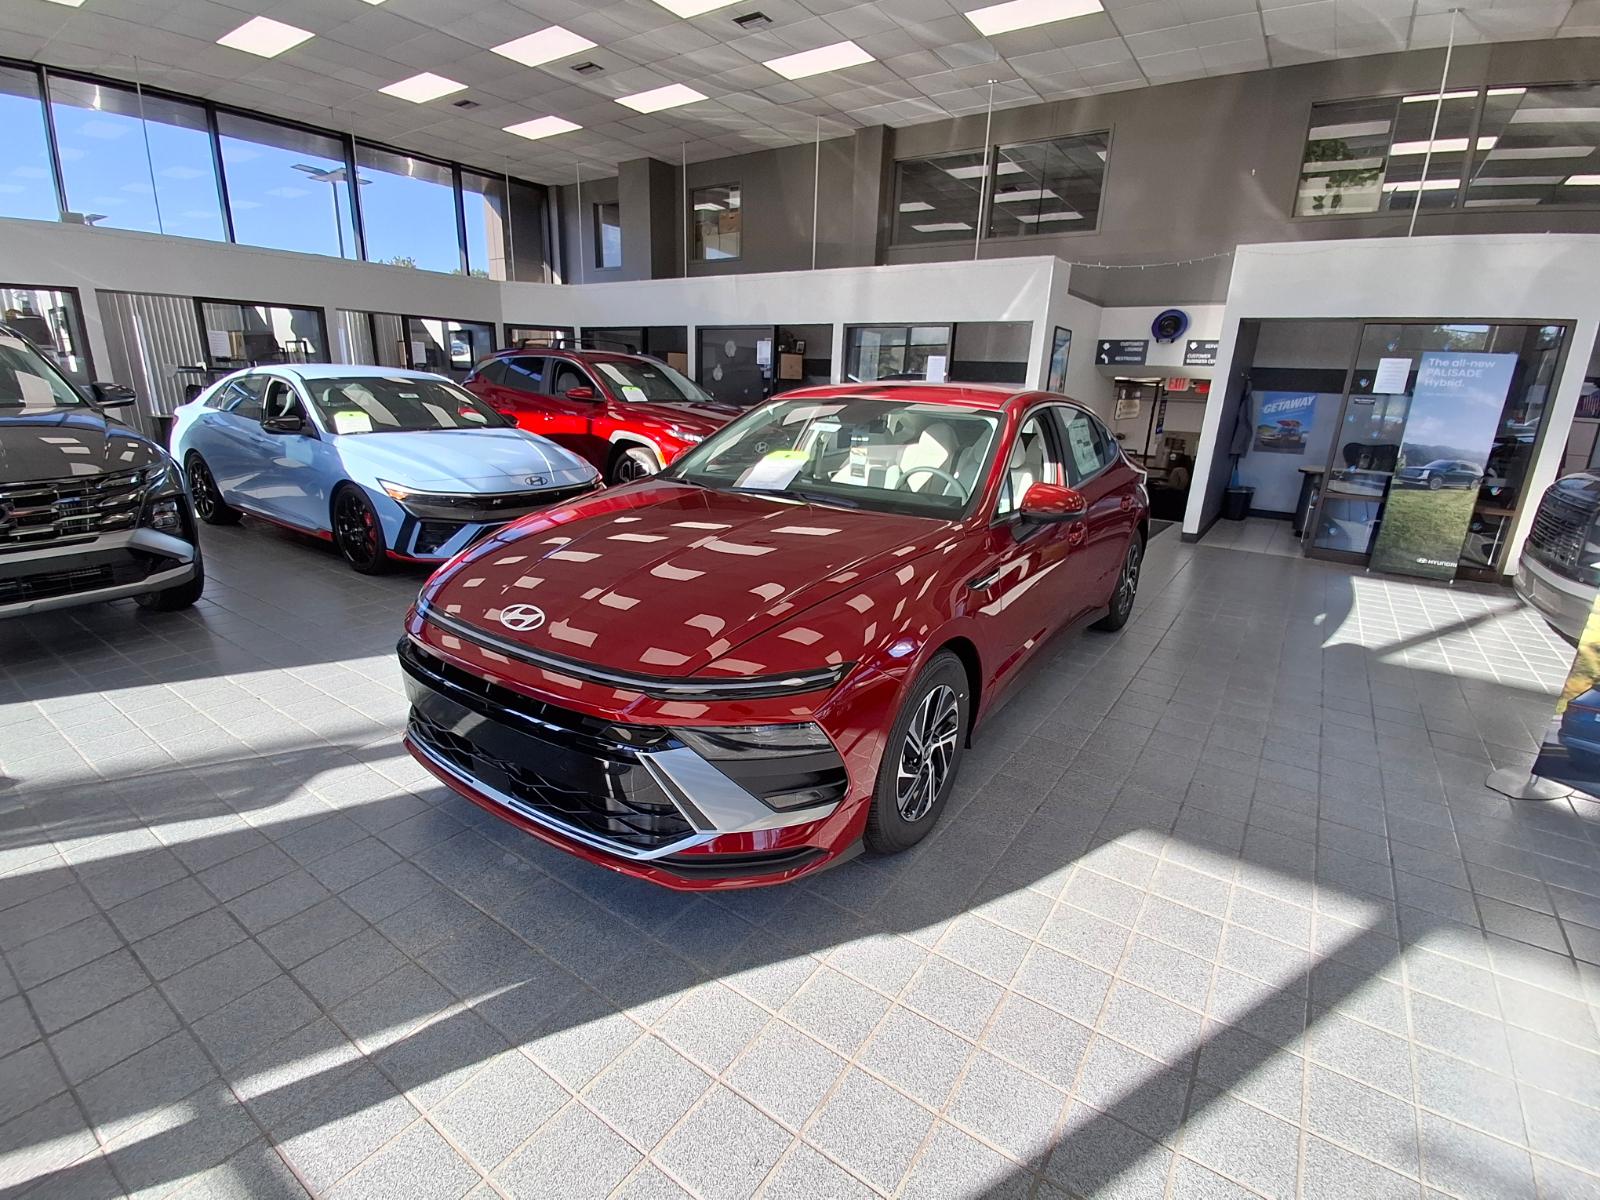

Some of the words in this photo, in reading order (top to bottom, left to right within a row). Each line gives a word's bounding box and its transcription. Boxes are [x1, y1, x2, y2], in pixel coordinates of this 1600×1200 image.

[1429, 358, 1449, 367] The
[1452, 359, 1496, 368] all-new
[1426, 368, 1484, 378] PALISADE
[1168, 378, 1187, 390] EXIT
[1424, 378, 1465, 388] Hybrid.
[1263, 395, 1316, 414] GETAWAY
[1427, 559, 1458, 568] HYUNDAI
